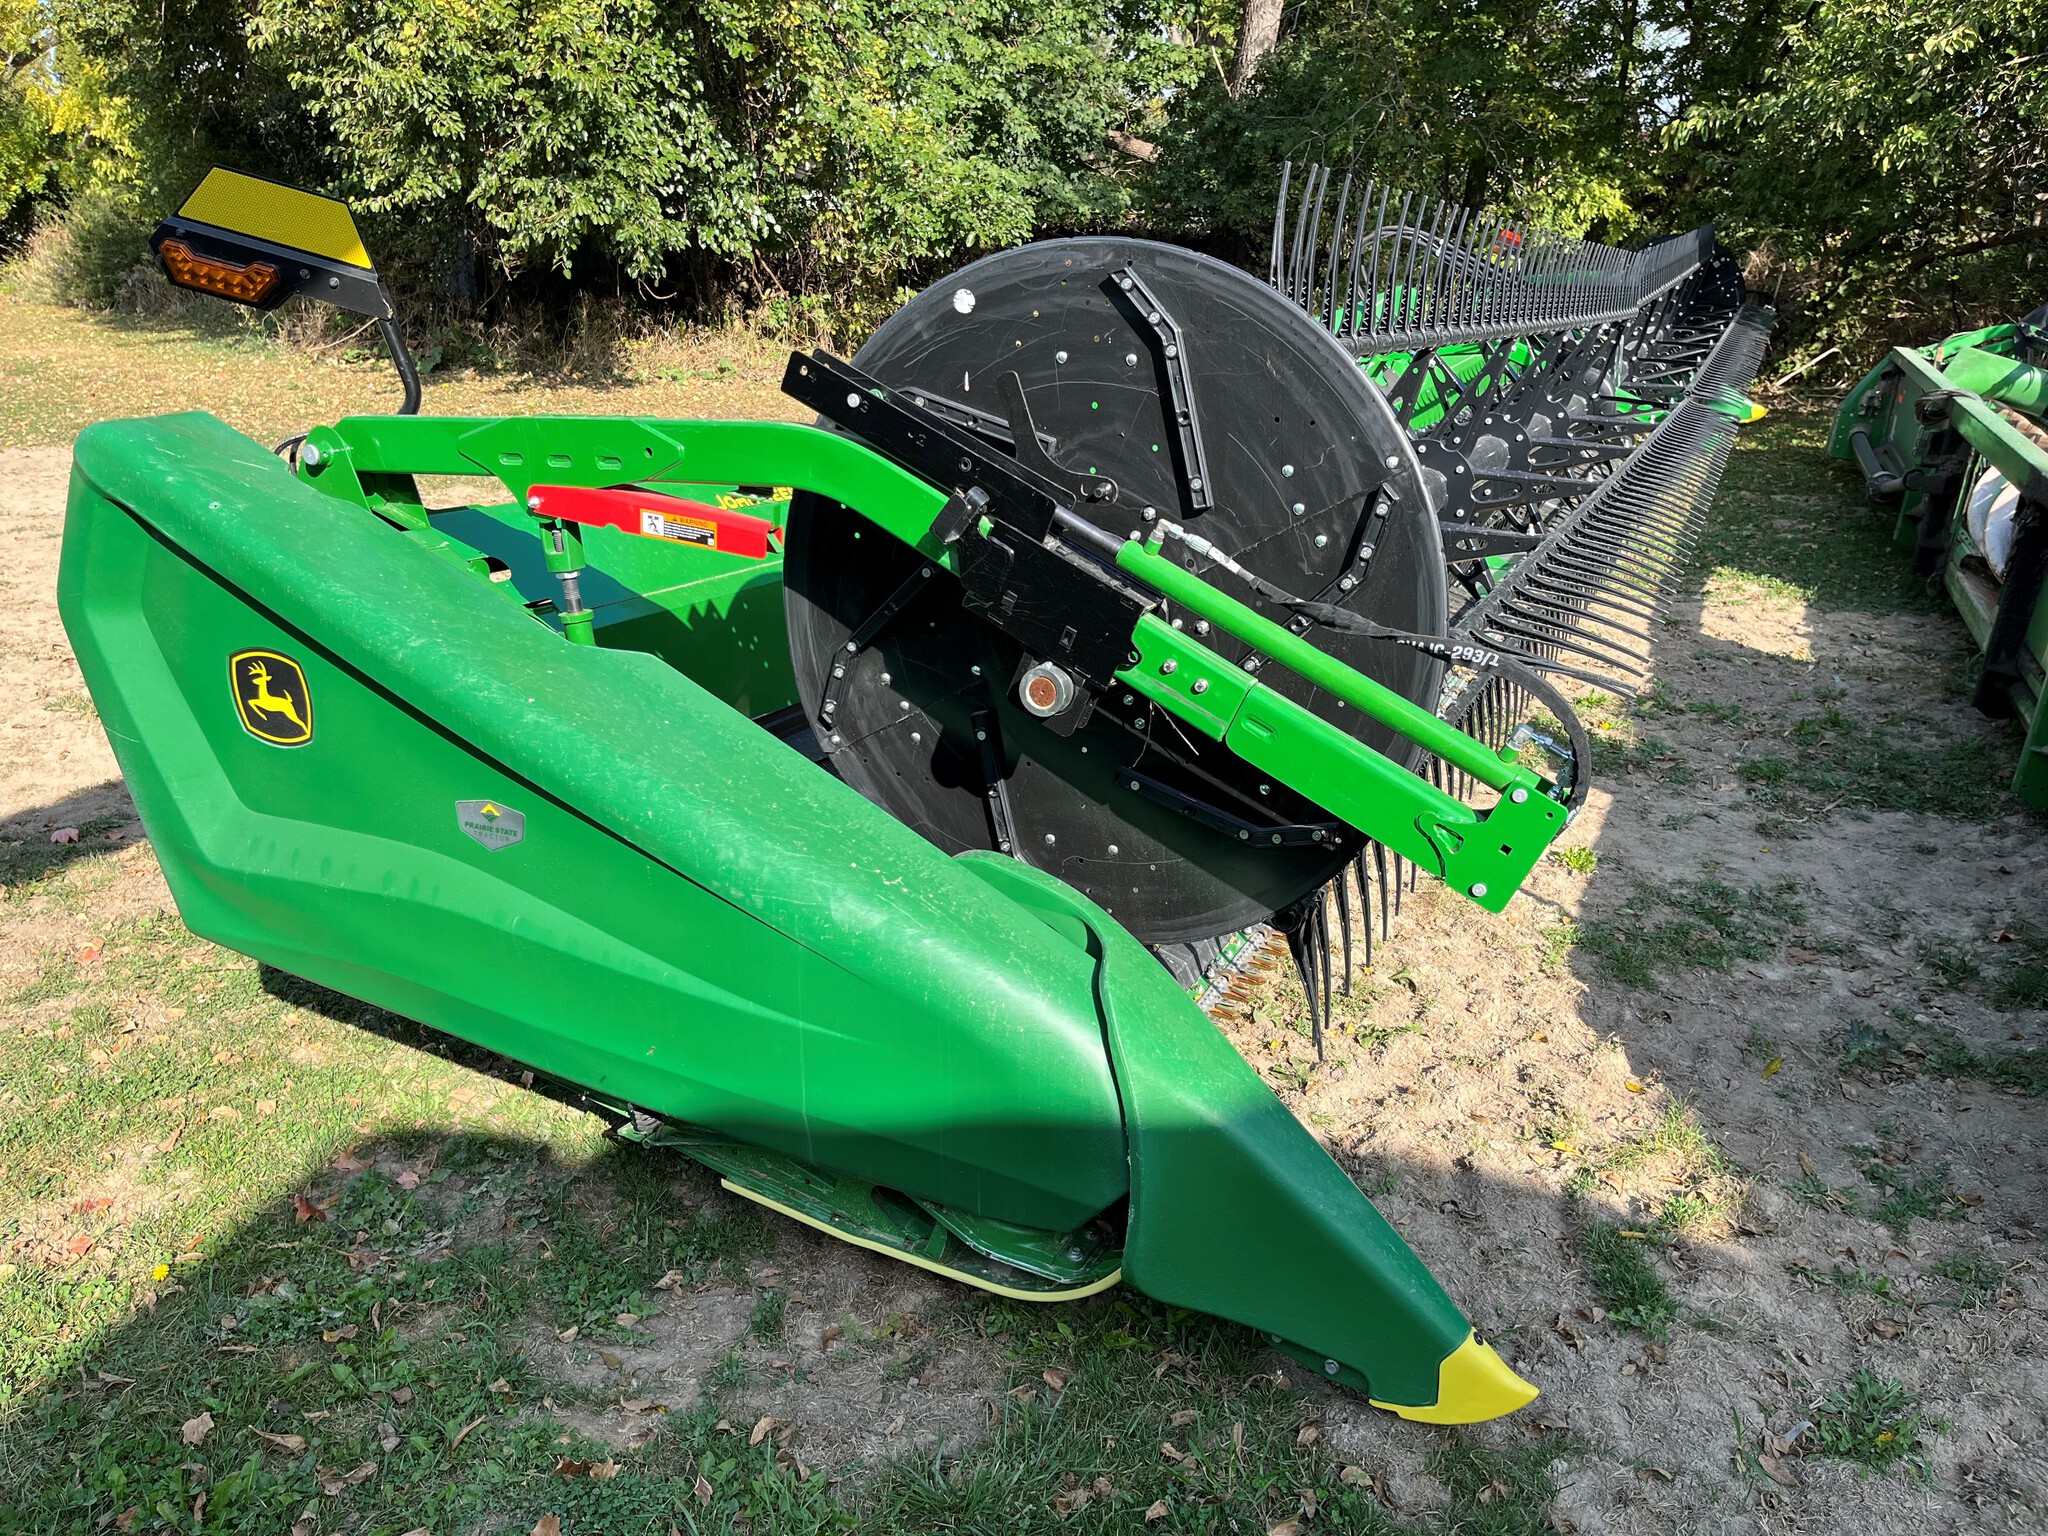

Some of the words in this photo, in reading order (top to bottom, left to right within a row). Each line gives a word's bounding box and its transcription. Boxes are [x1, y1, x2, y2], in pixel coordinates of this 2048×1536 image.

[679, 517, 708, 528] WARNING
[464, 821, 494, 832] PRAIRIE
[495, 827, 518, 837] STATE
[474, 830, 510, 841] TRACTOR
